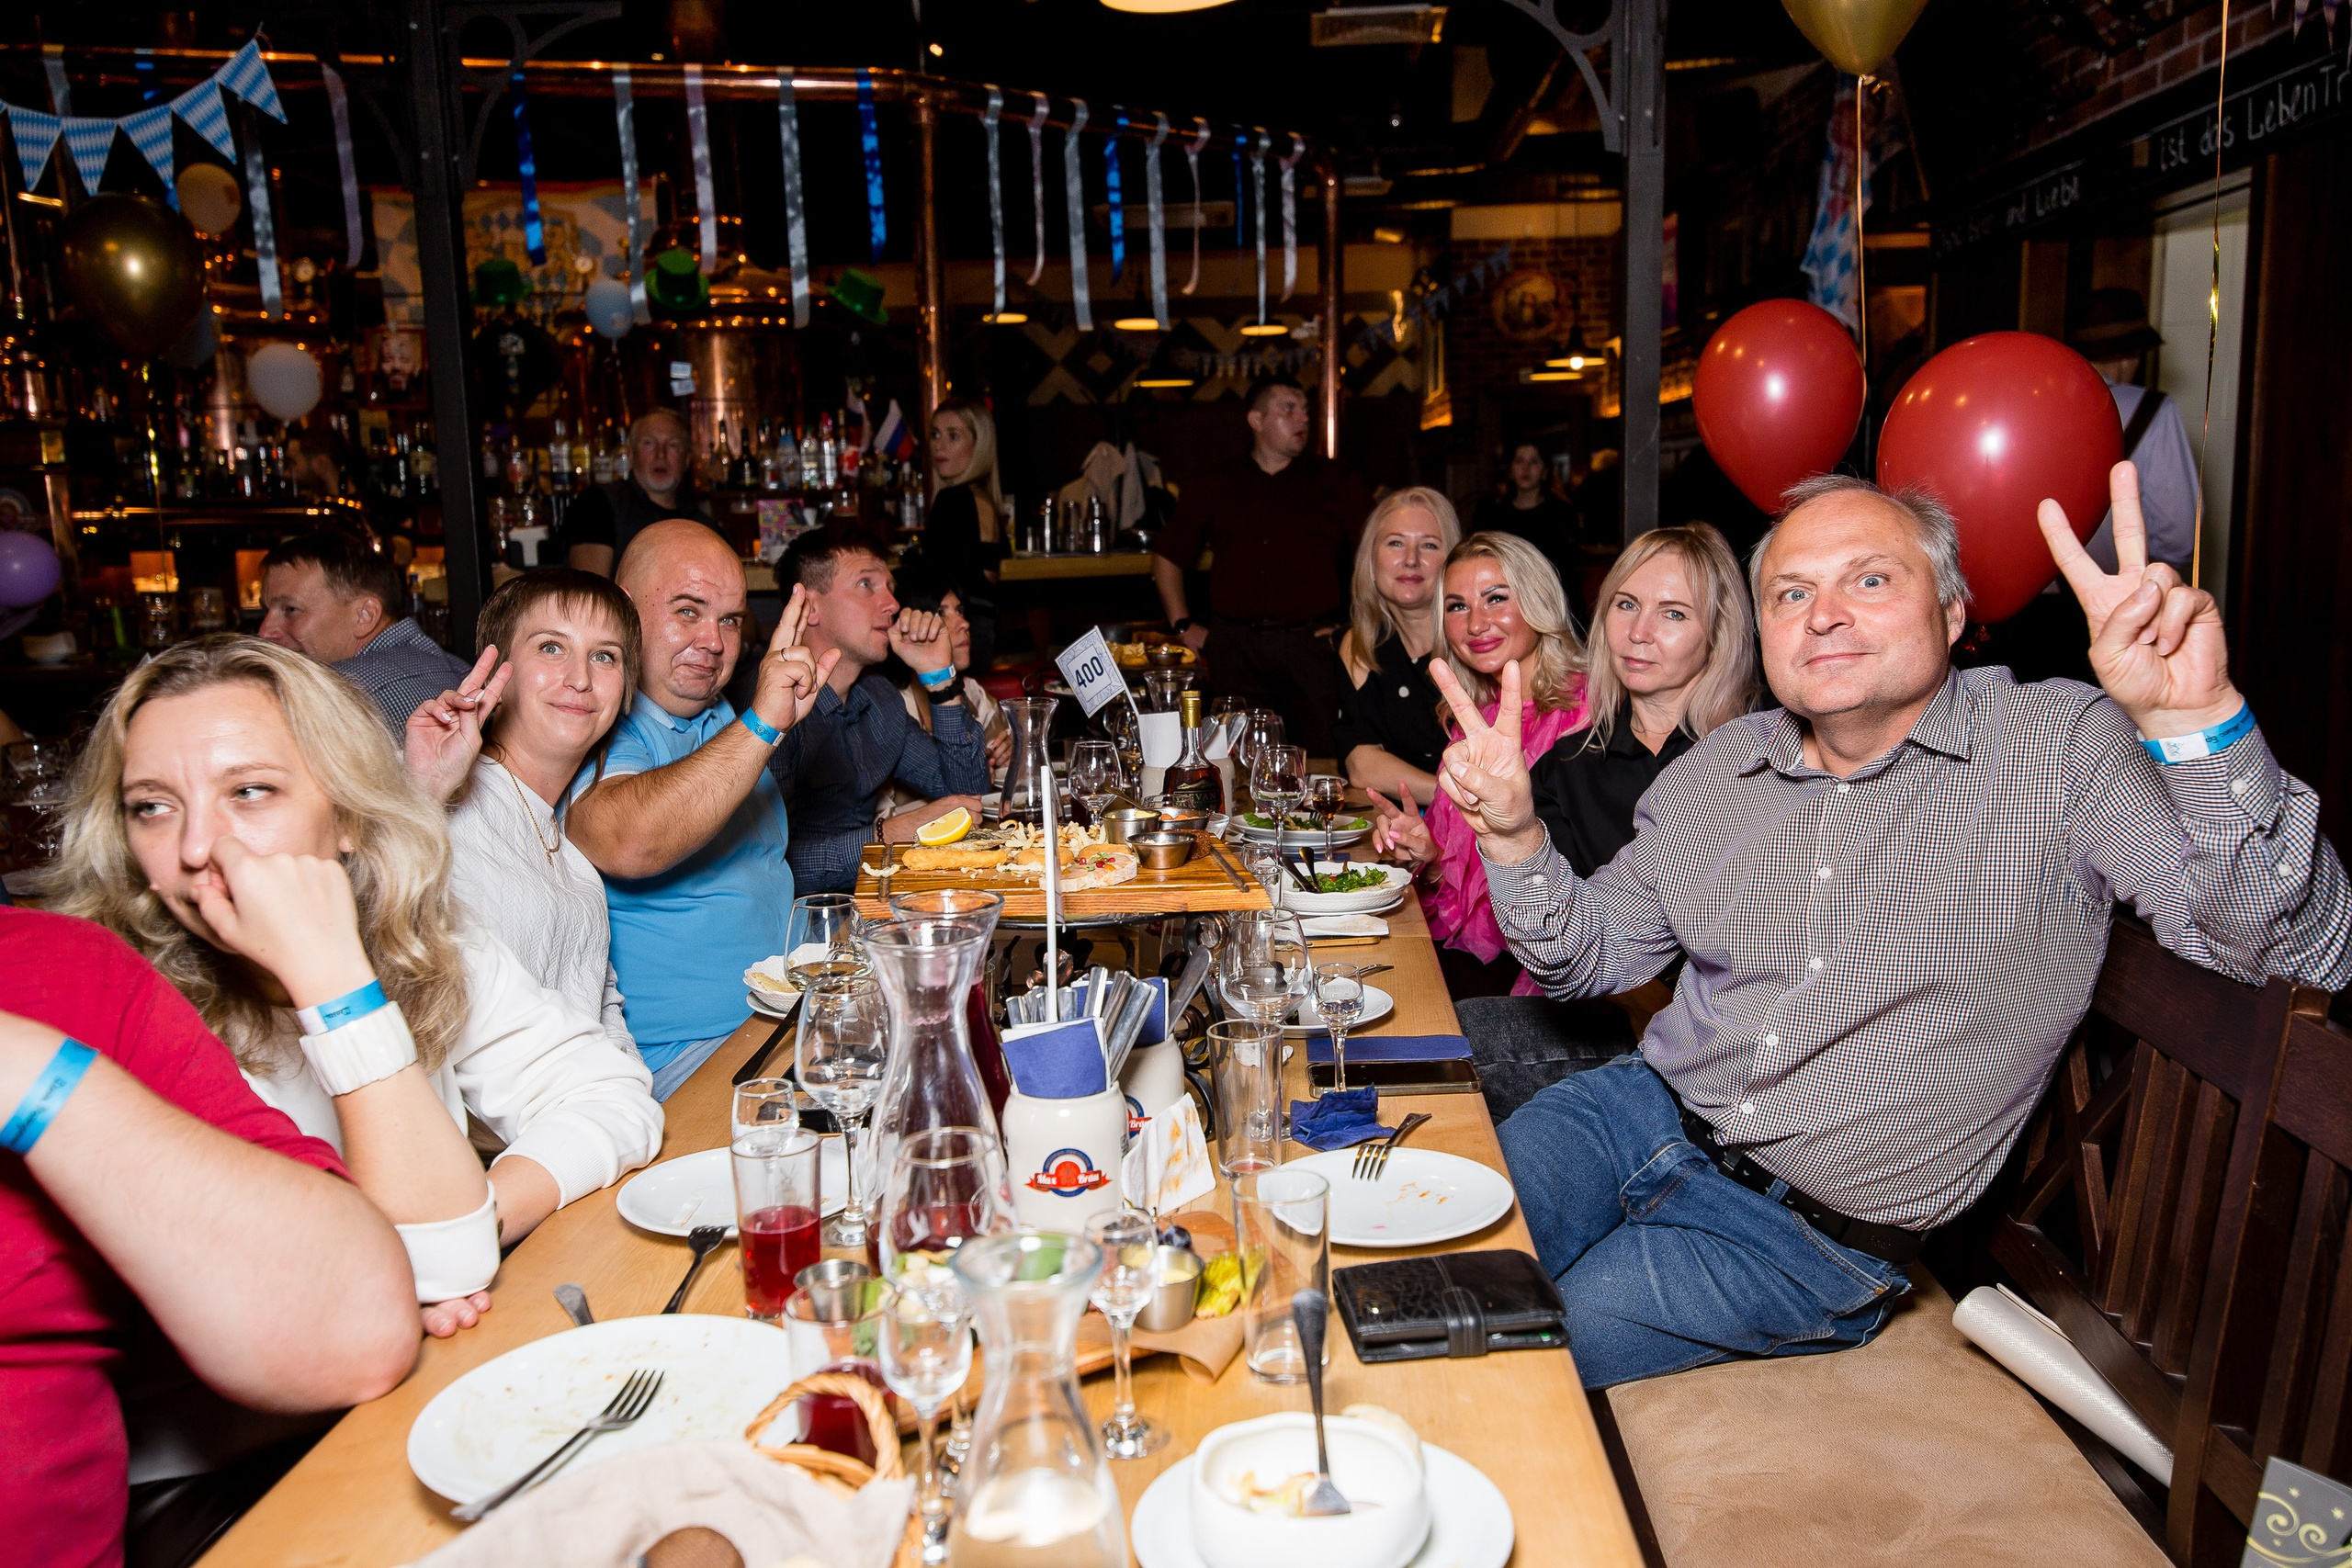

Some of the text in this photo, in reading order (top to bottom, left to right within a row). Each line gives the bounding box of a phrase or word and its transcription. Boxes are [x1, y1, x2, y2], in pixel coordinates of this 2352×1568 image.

[2161, 125, 2189, 172] ist
[2199, 114, 2234, 155] das
[2247, 81, 2316, 140] Leben
[1075, 656, 1104, 688] 400
[1036, 1174, 1057, 1185] Max
